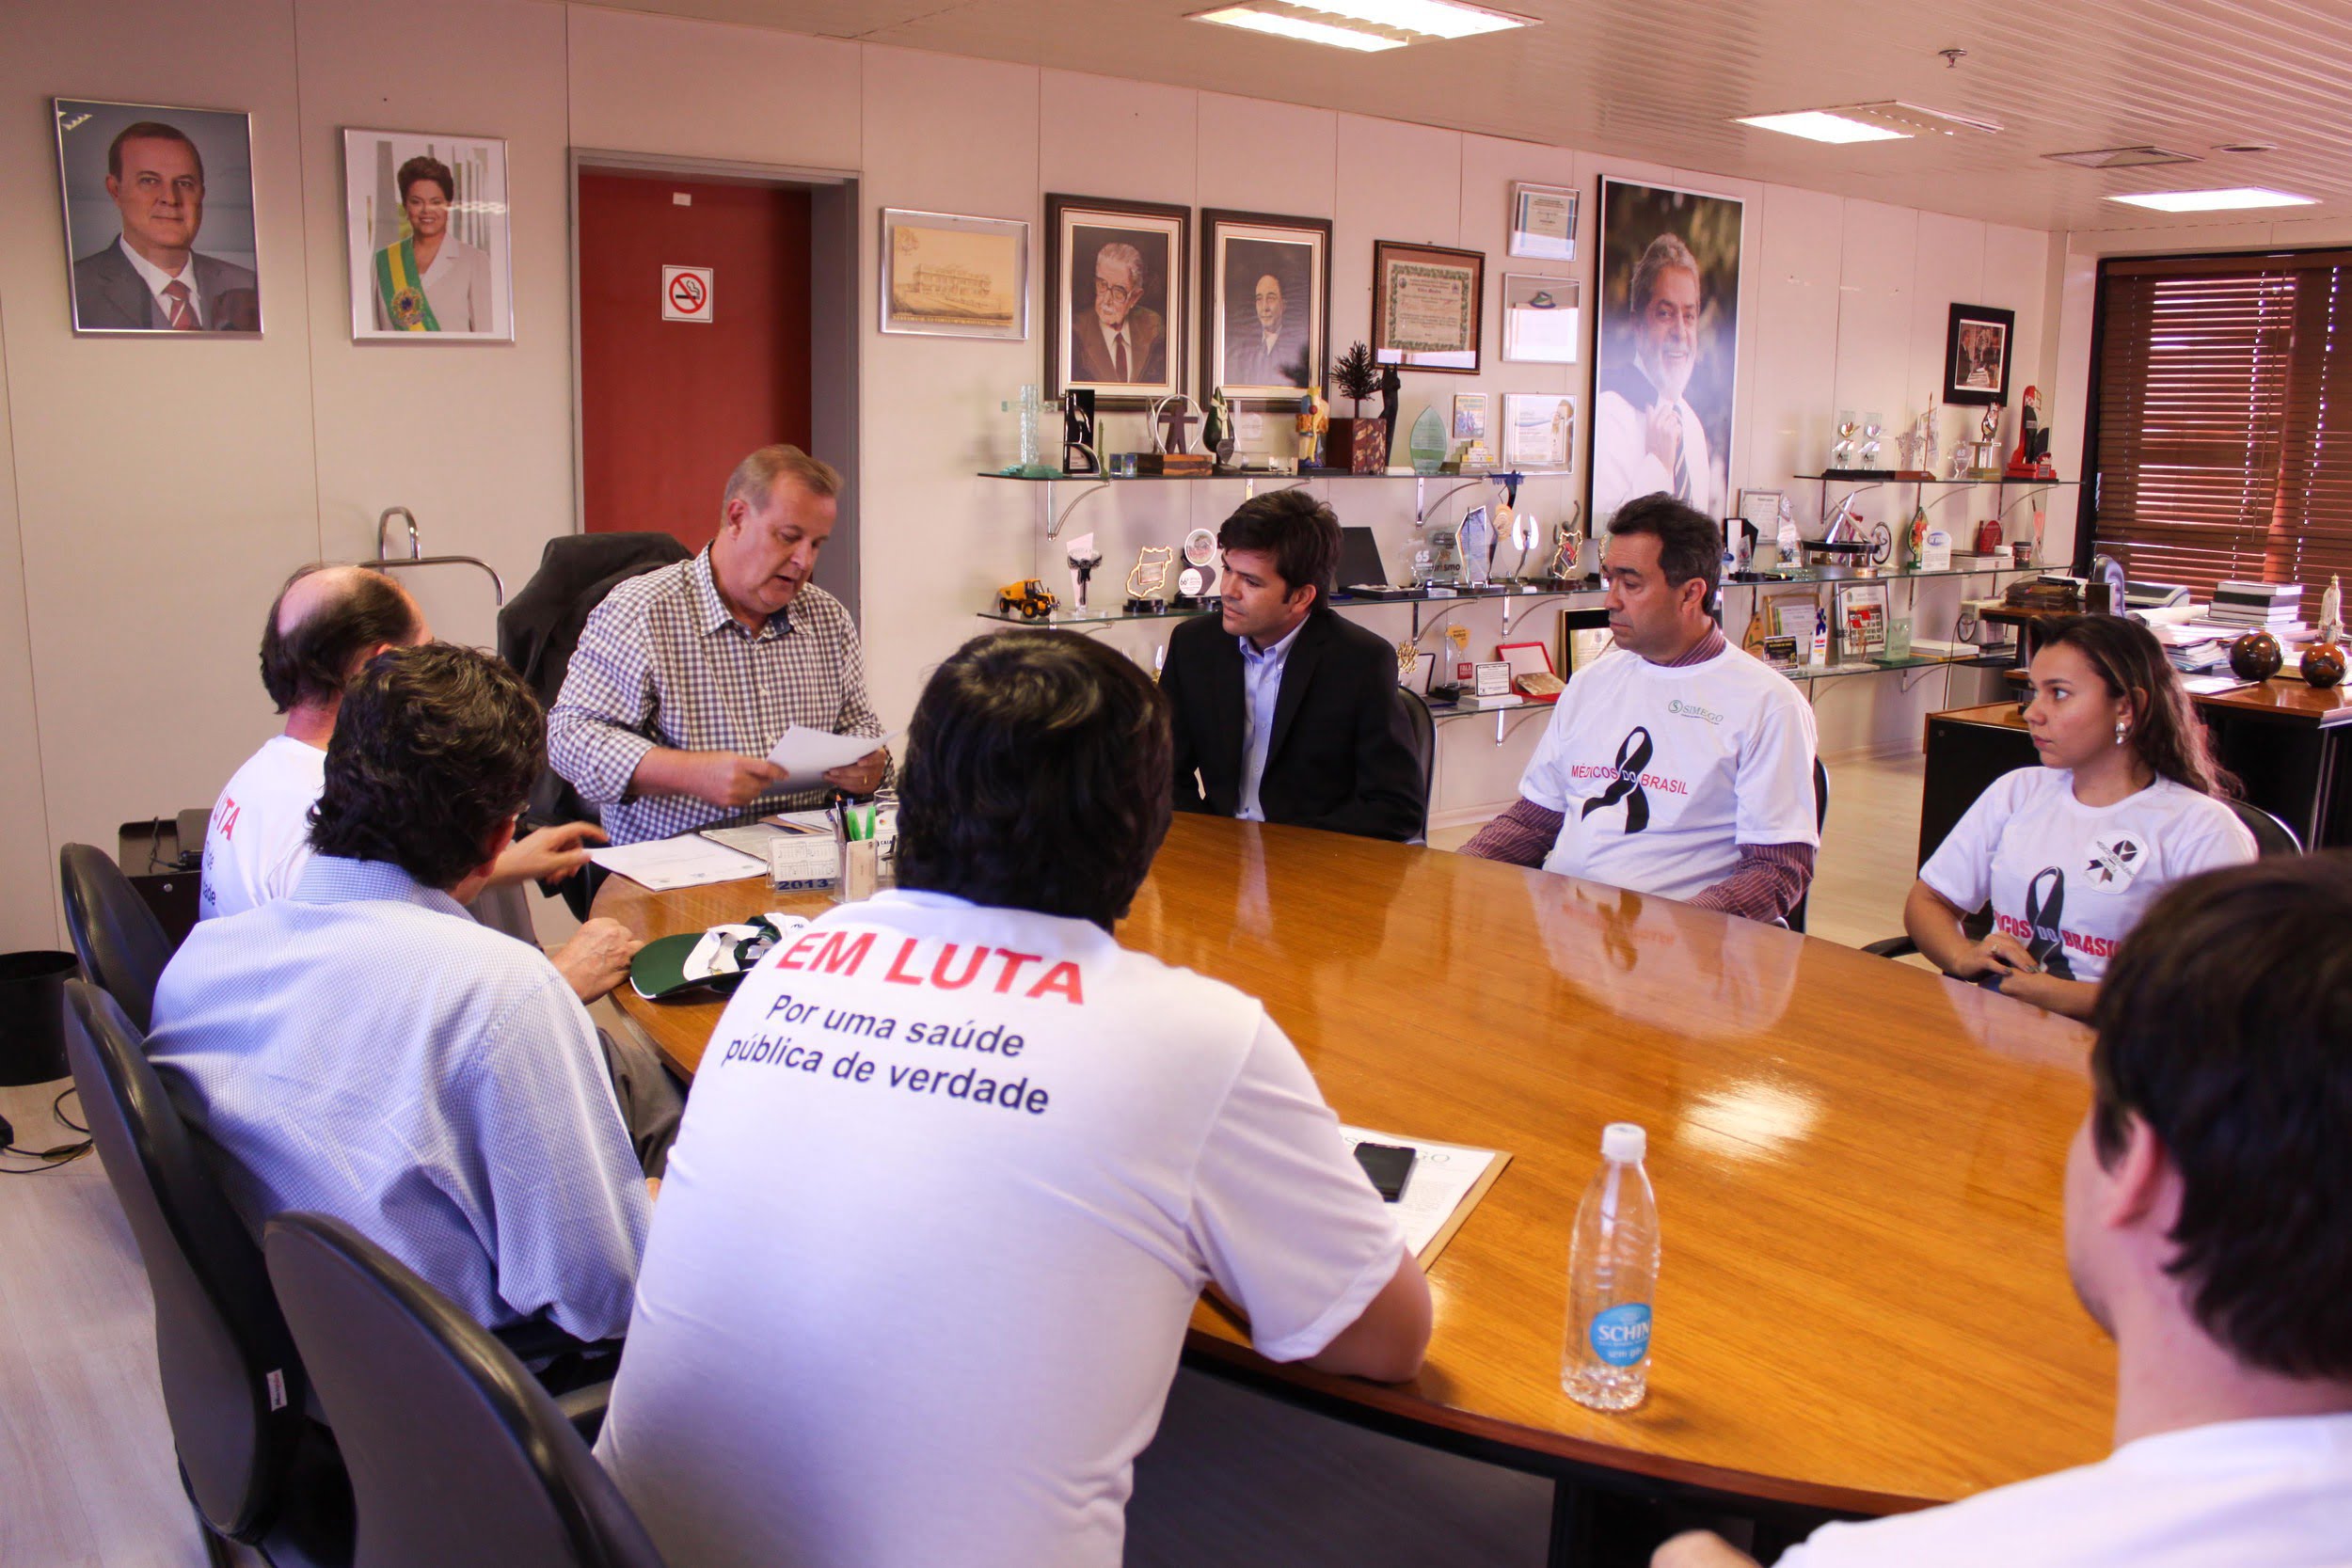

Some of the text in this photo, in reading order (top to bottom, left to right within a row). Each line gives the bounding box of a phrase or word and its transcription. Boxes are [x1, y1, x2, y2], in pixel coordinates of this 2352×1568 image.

[1415, 549, 1430, 562] 65
[1682, 705, 1724, 722] SIMEGO
[1571, 763, 1689, 795] MÉDICOS DO BRASIL
[778, 879, 829, 891] 2013
[2037, 925, 2058, 941] DO
[776, 931, 1084, 1005] EM LUTA
[765, 994, 1025, 1057] Por uma saúde
[721, 1033, 1050, 1116] pública de verdade
